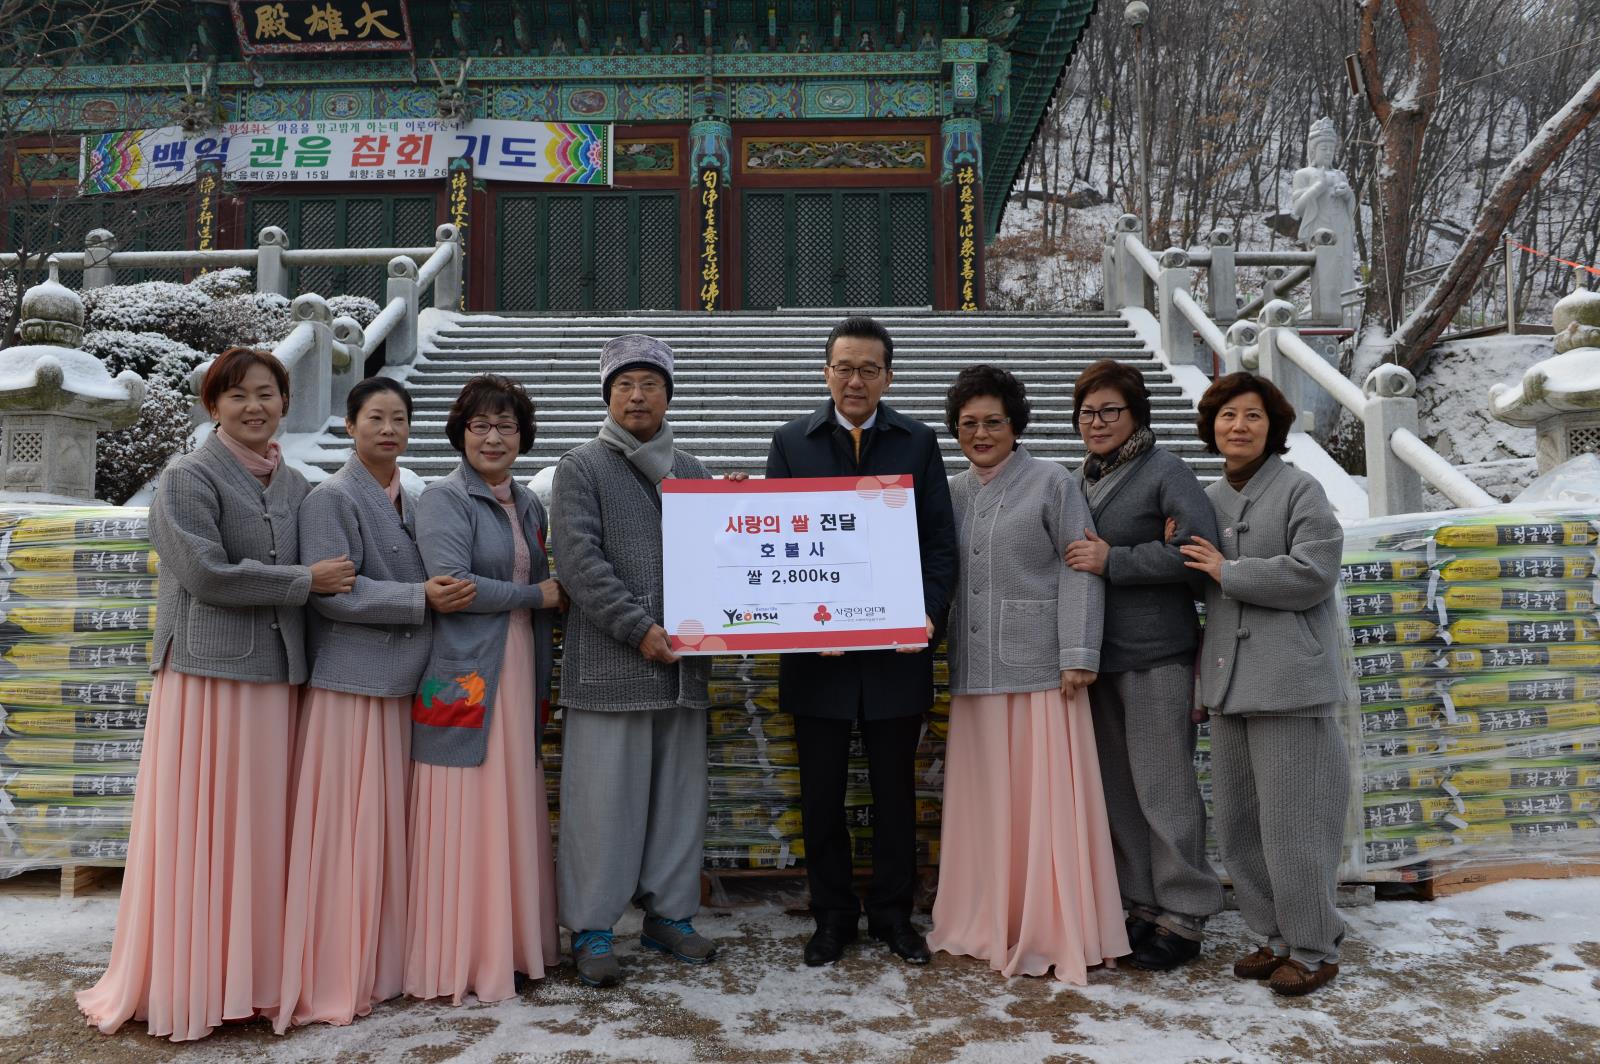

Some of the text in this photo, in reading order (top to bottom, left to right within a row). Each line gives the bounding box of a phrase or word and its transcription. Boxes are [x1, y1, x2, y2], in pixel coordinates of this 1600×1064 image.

[278, 122, 310, 134] 마음을
[152, 133, 537, 172] 백일 관음 참회 기도
[306, 170, 330, 180] 15일
[403, 168, 427, 178] 12월
[433, 168, 449, 178] 26
[725, 513, 857, 534] 사랑의 쌀 전달
[747, 568, 840, 585] 쌀 2,800kg
[723, 608, 778, 625] Yeonsu
[834, 606, 886, 618] 사랑의 열매
